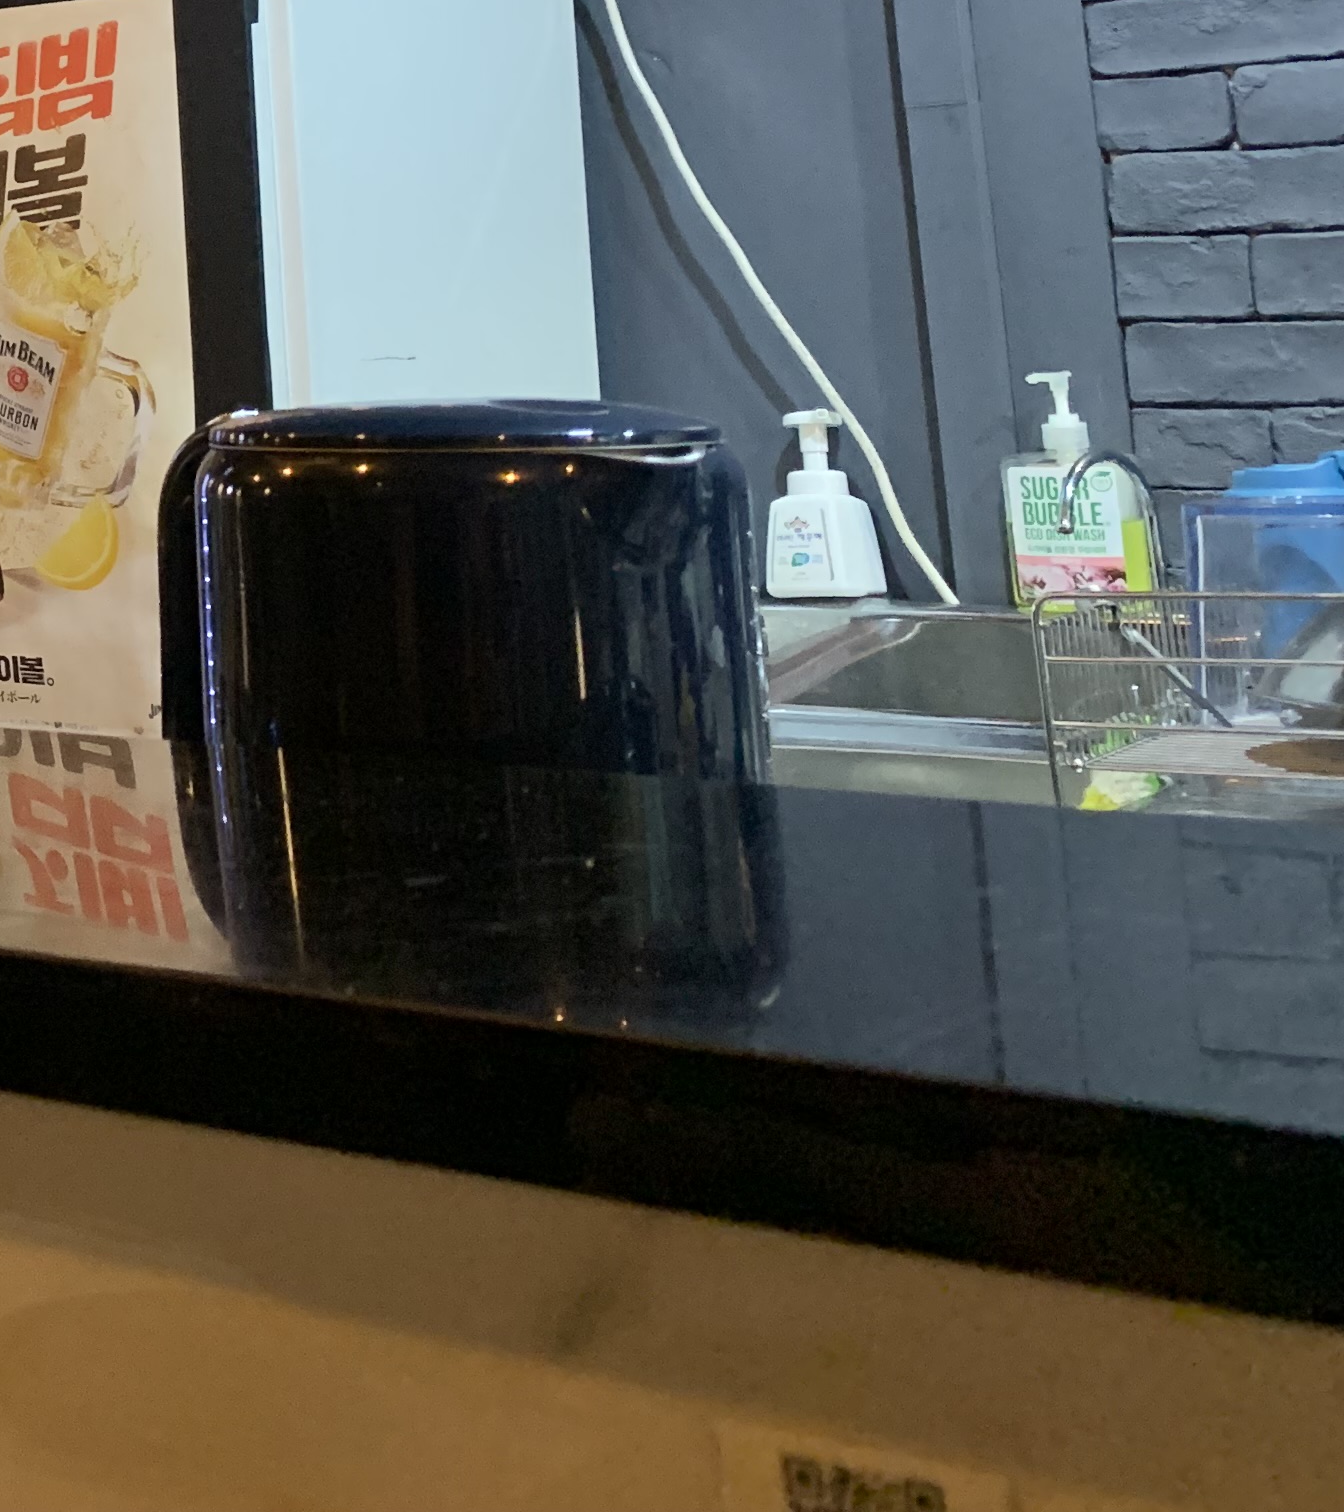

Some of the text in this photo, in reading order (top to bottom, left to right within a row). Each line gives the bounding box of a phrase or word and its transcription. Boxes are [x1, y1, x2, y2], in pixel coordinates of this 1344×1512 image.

[17, 340, 56, 386] BEAM
[1025, 527, 1044, 541] ECO
[1074, 528, 1106, 542] WASH
